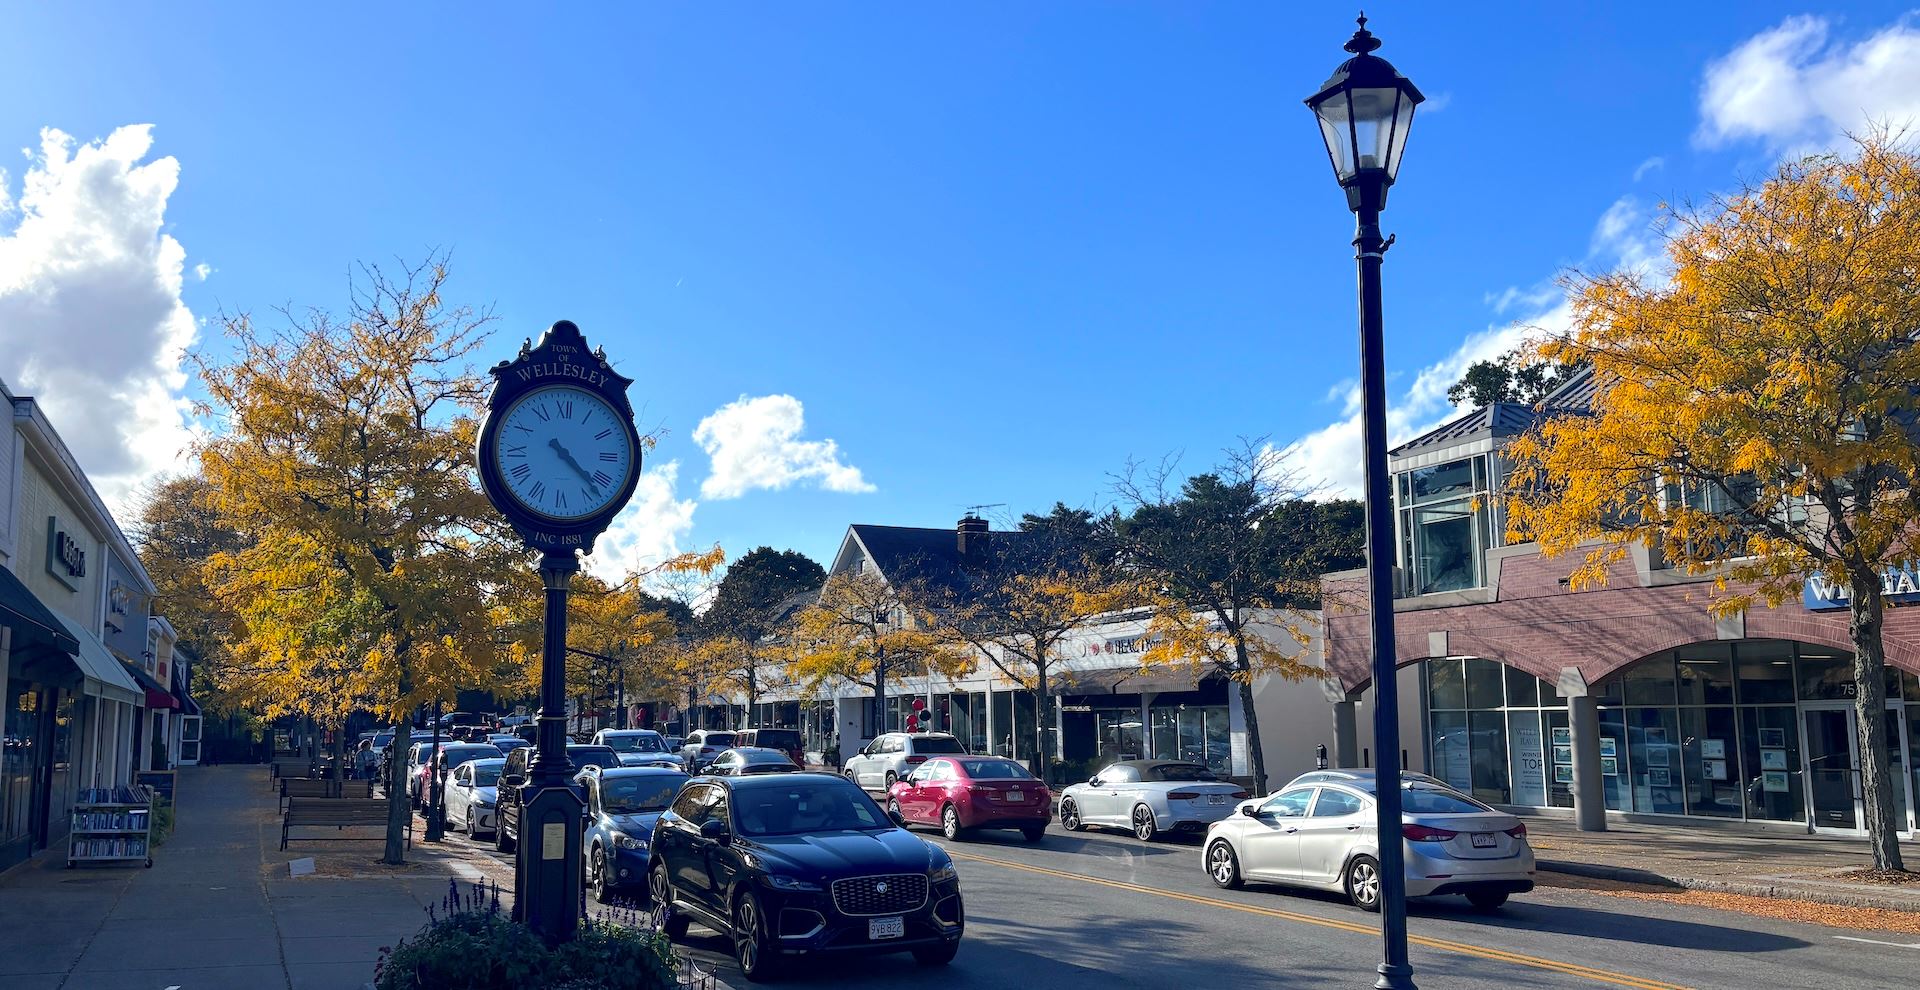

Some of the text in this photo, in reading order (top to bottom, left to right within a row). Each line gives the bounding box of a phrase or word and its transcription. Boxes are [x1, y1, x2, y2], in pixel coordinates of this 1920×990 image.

[551, 344, 578, 354] TOWN
[558, 354, 569, 362] OF
[516, 362, 609, 388] WELLESLEY
[556, 400, 573, 419] XII
[535, 531, 582, 545] INC 1881
[1840, 684, 1855, 695] 75
